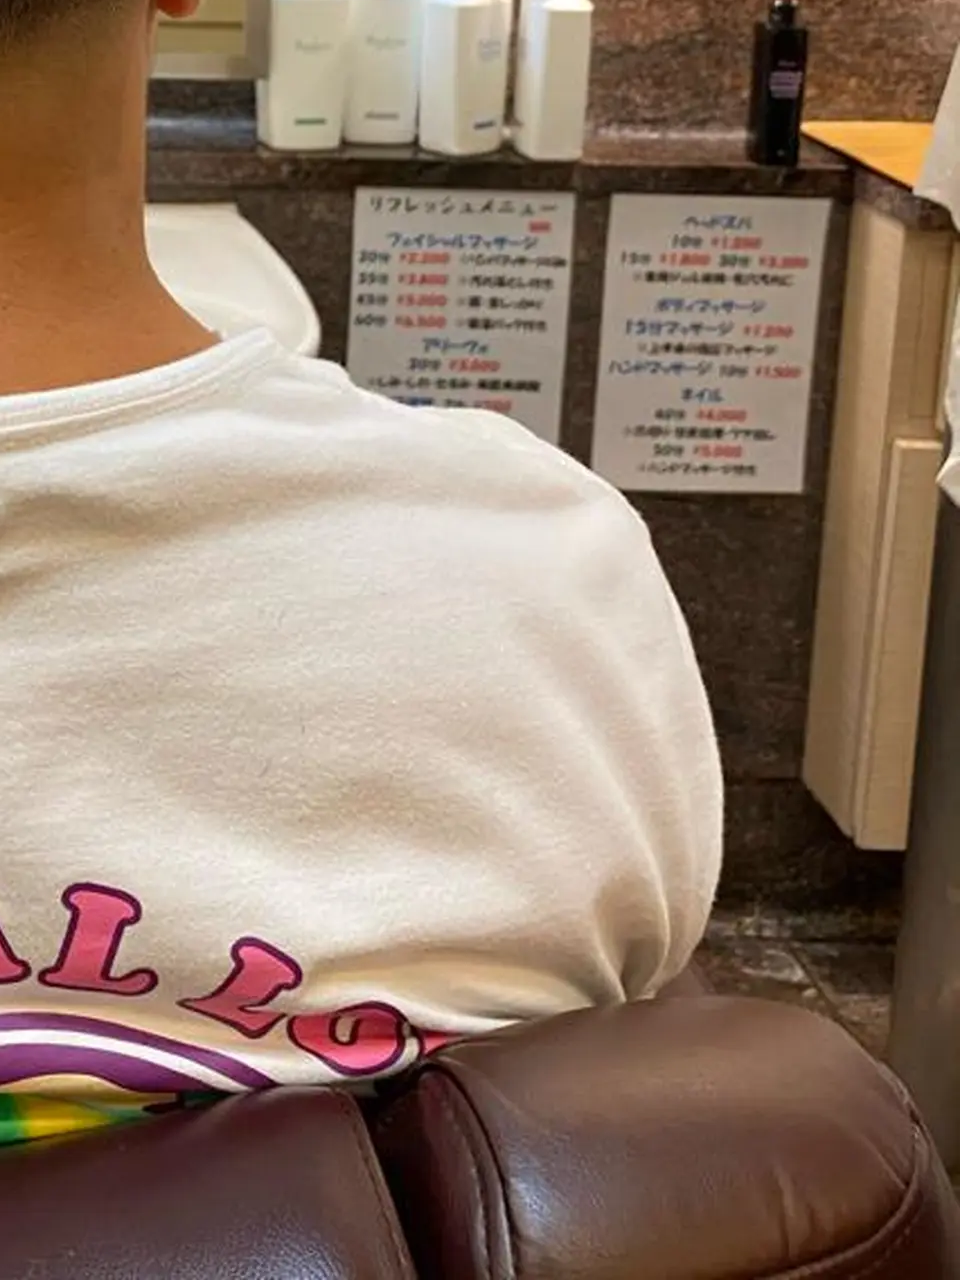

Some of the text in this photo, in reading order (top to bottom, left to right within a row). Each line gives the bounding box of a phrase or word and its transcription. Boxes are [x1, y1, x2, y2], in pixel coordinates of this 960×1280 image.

[370, 195, 558, 216] リフレッシュメニュー
[181, 935, 465, 1077] LO
